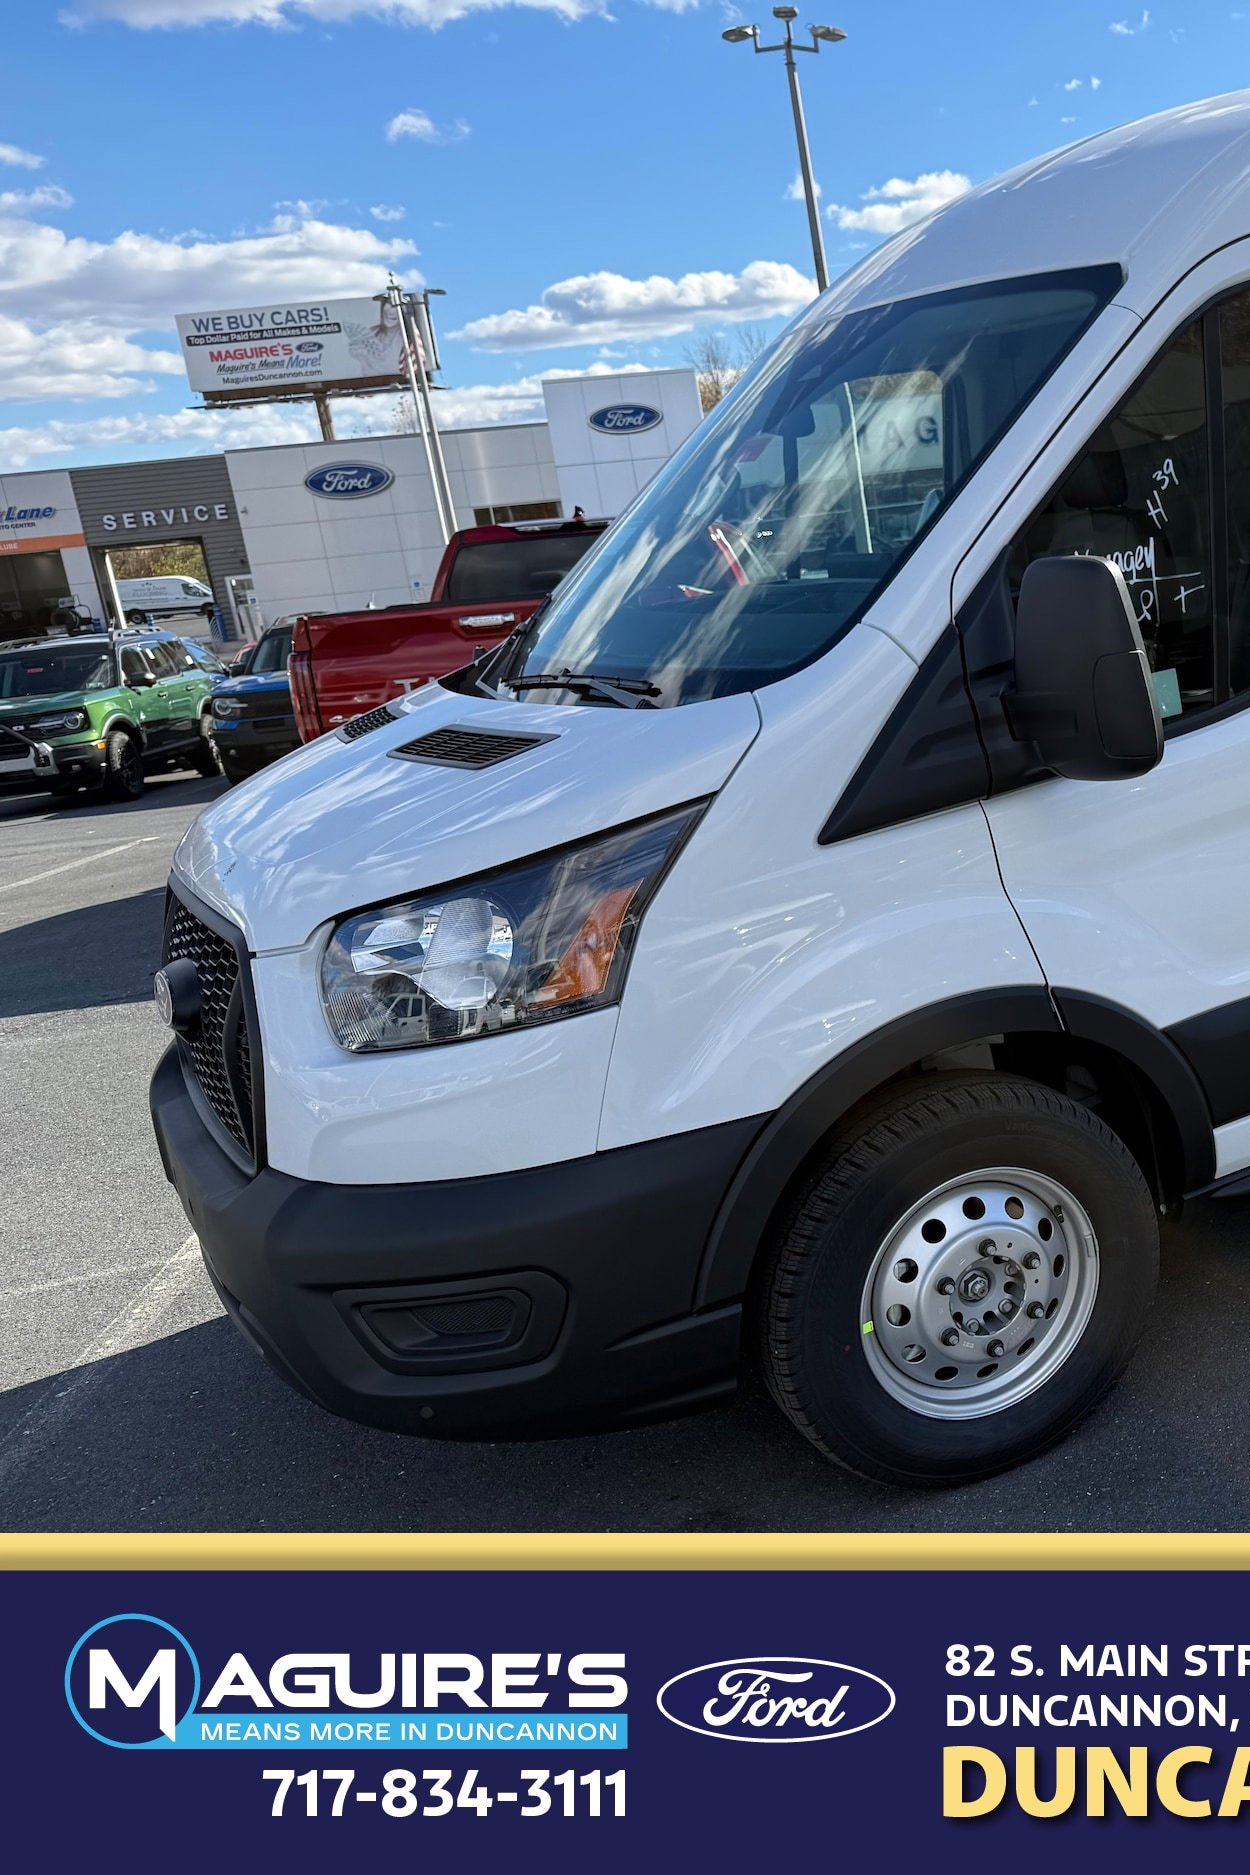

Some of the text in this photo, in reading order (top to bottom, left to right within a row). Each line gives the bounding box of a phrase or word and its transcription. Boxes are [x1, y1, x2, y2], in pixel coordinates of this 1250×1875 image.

[192, 306, 329, 333] WE BUY CARS!
[189, 323, 339, 345] Top Dollar Paid for All Makes & Models
[209, 342, 294, 362] MAGUIRE'S
[216, 353, 322, 374] Maguire's Means More!
[222, 369, 323, 385] MaguiresDuncannon.com
[603, 409, 646, 428] Ford
[321, 469, 372, 492] Ford
[4, 505, 54, 521] Lane
[103, 503, 229, 531] SERVICE
[10, 521, 36, 529] CENTER
